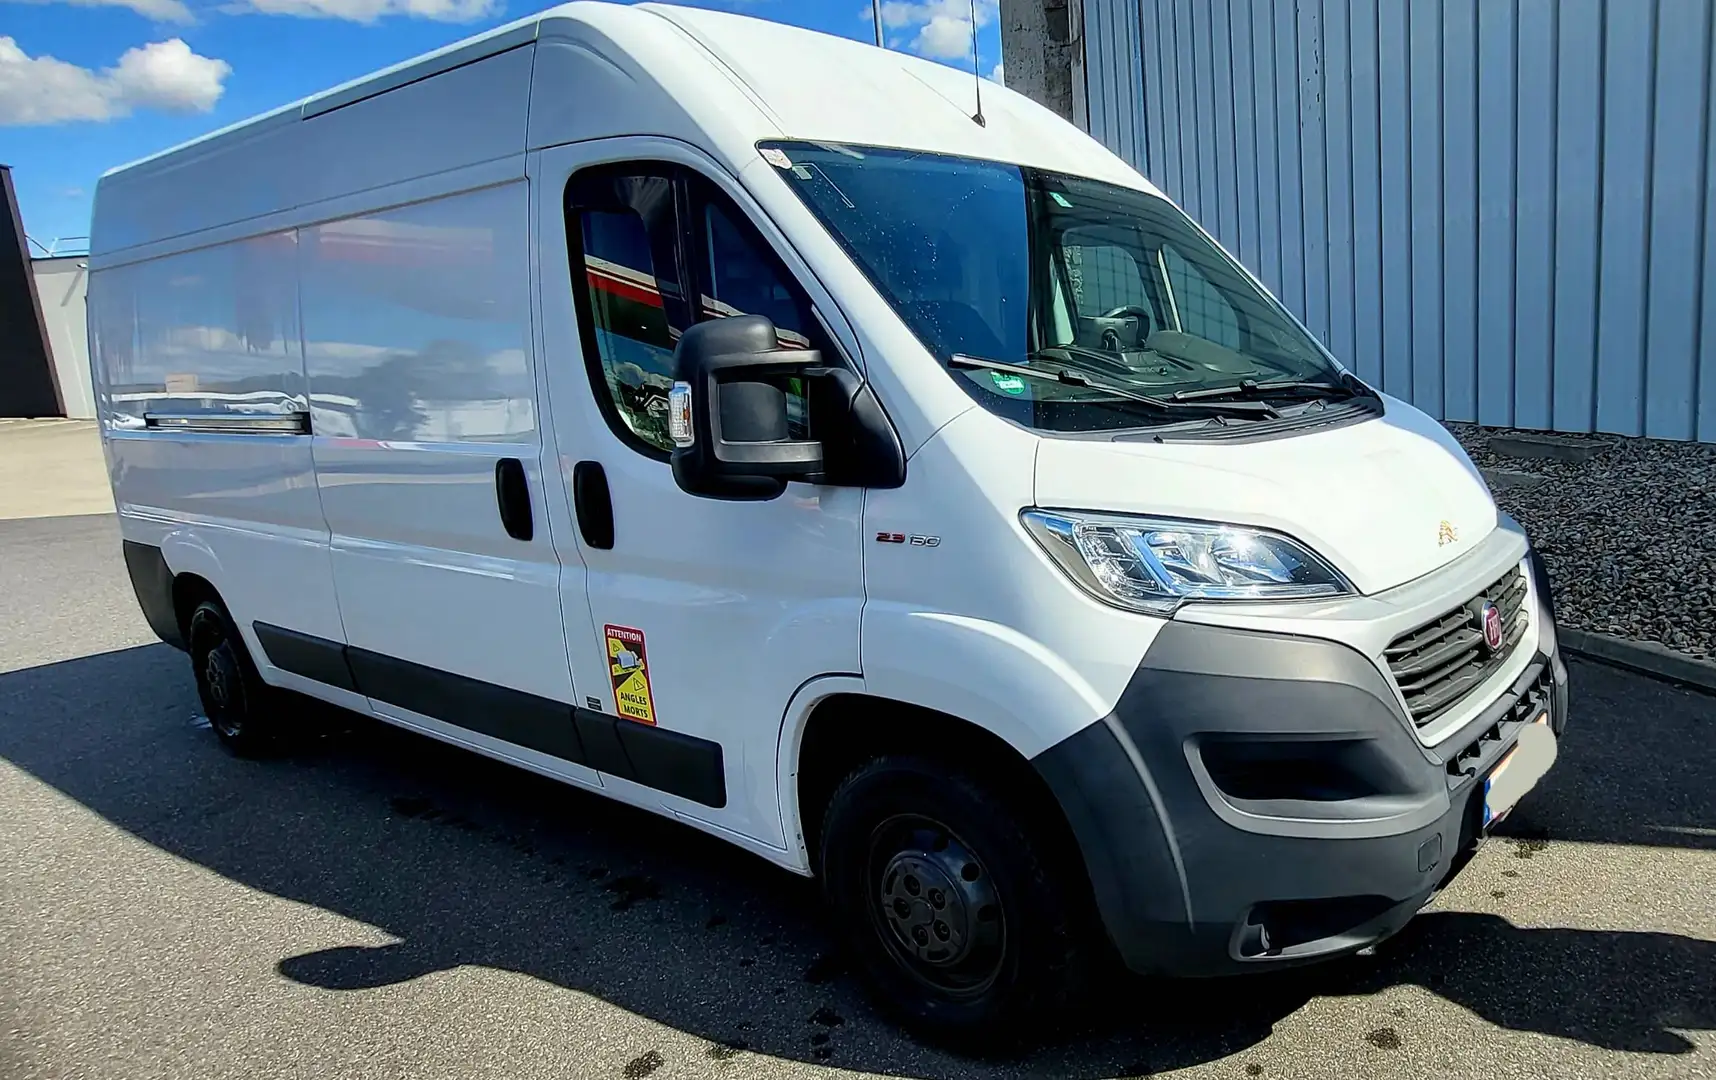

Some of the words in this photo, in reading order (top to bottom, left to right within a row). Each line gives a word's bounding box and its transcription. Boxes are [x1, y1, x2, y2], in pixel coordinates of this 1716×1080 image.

[607, 628, 642, 642] ATTENTION
[620, 692, 647, 705] ANGLES
[623, 704, 648, 718] MORTS
